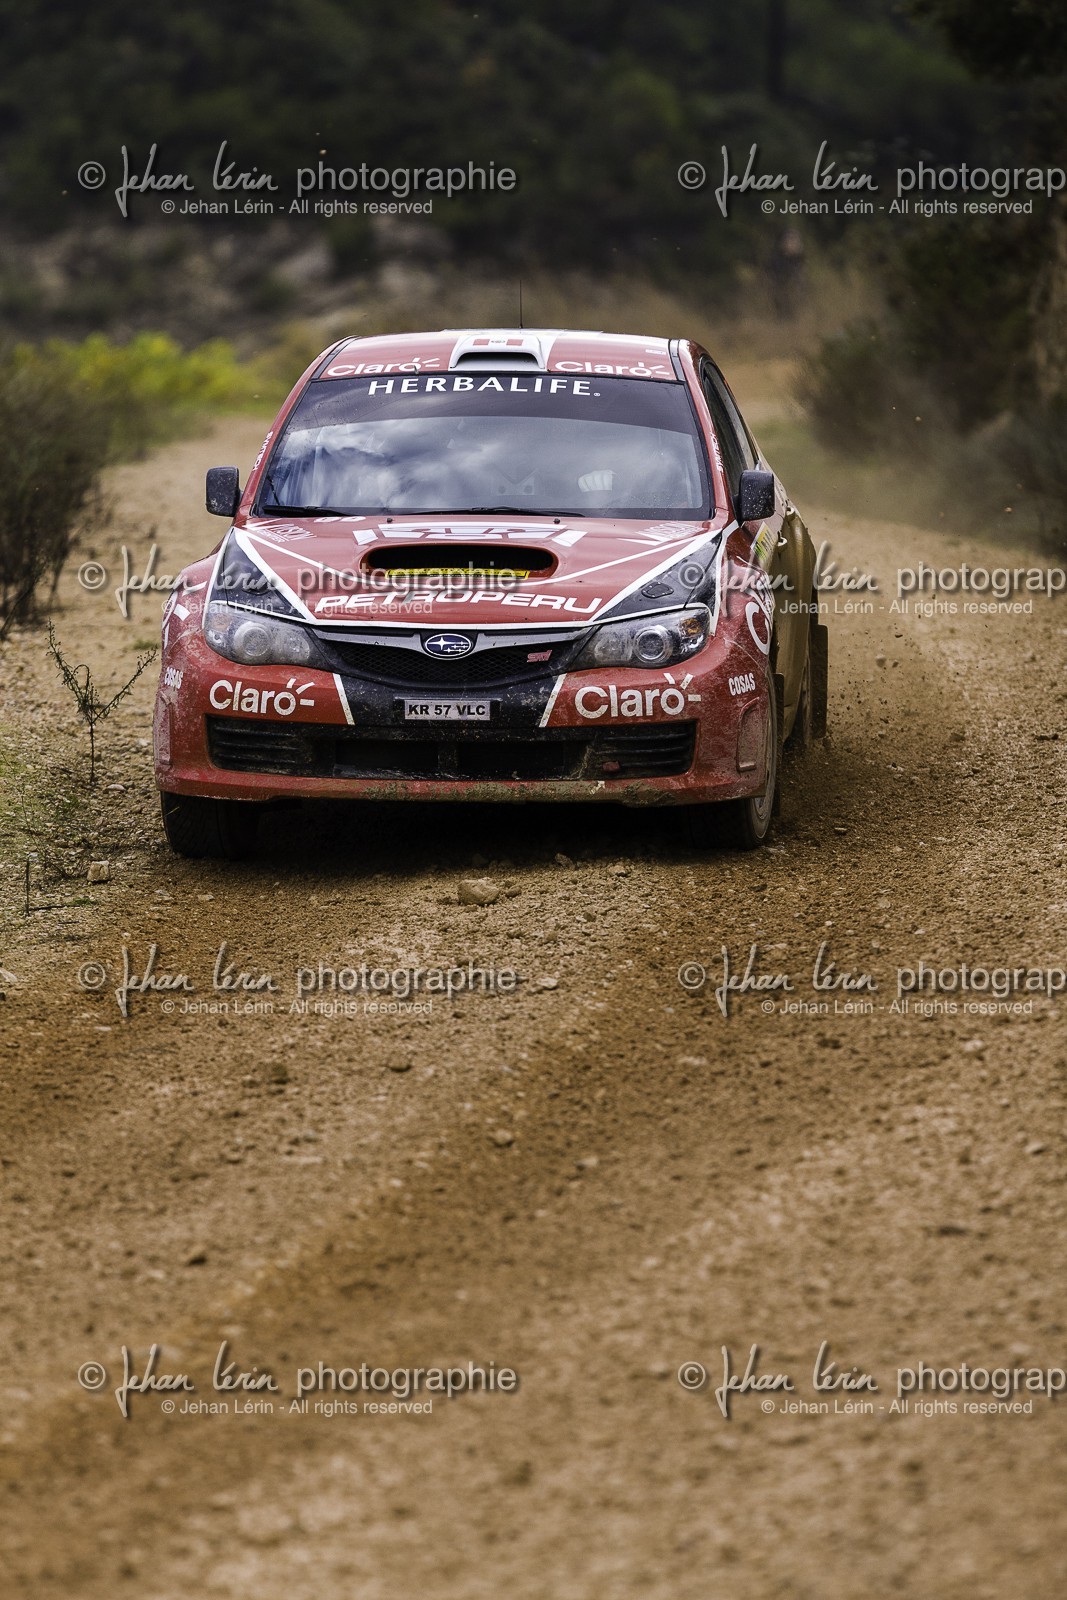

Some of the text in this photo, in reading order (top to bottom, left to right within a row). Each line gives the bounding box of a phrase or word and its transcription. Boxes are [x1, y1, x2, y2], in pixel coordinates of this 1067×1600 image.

[367, 376, 592, 396] HERBALIFE
[314, 589, 603, 614] PETROPERU
[728, 672, 756, 697] COSAS
[408, 704, 487, 716] KR 57 VLC
